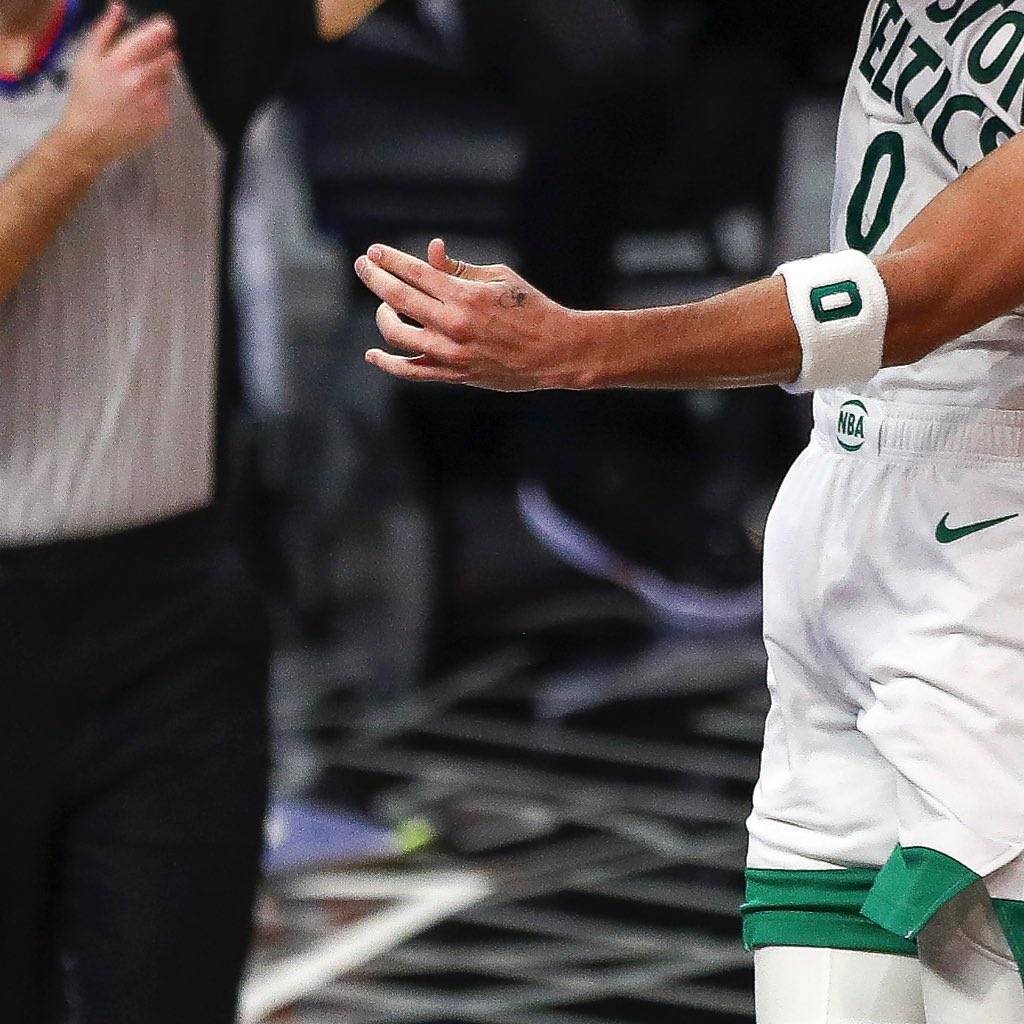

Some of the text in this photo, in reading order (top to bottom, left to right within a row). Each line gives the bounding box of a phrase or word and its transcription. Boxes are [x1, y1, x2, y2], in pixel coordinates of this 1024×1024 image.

[845, 131, 906, 251] 0
[810, 279, 863, 322] 0
[837, 410, 865, 438] NBA
